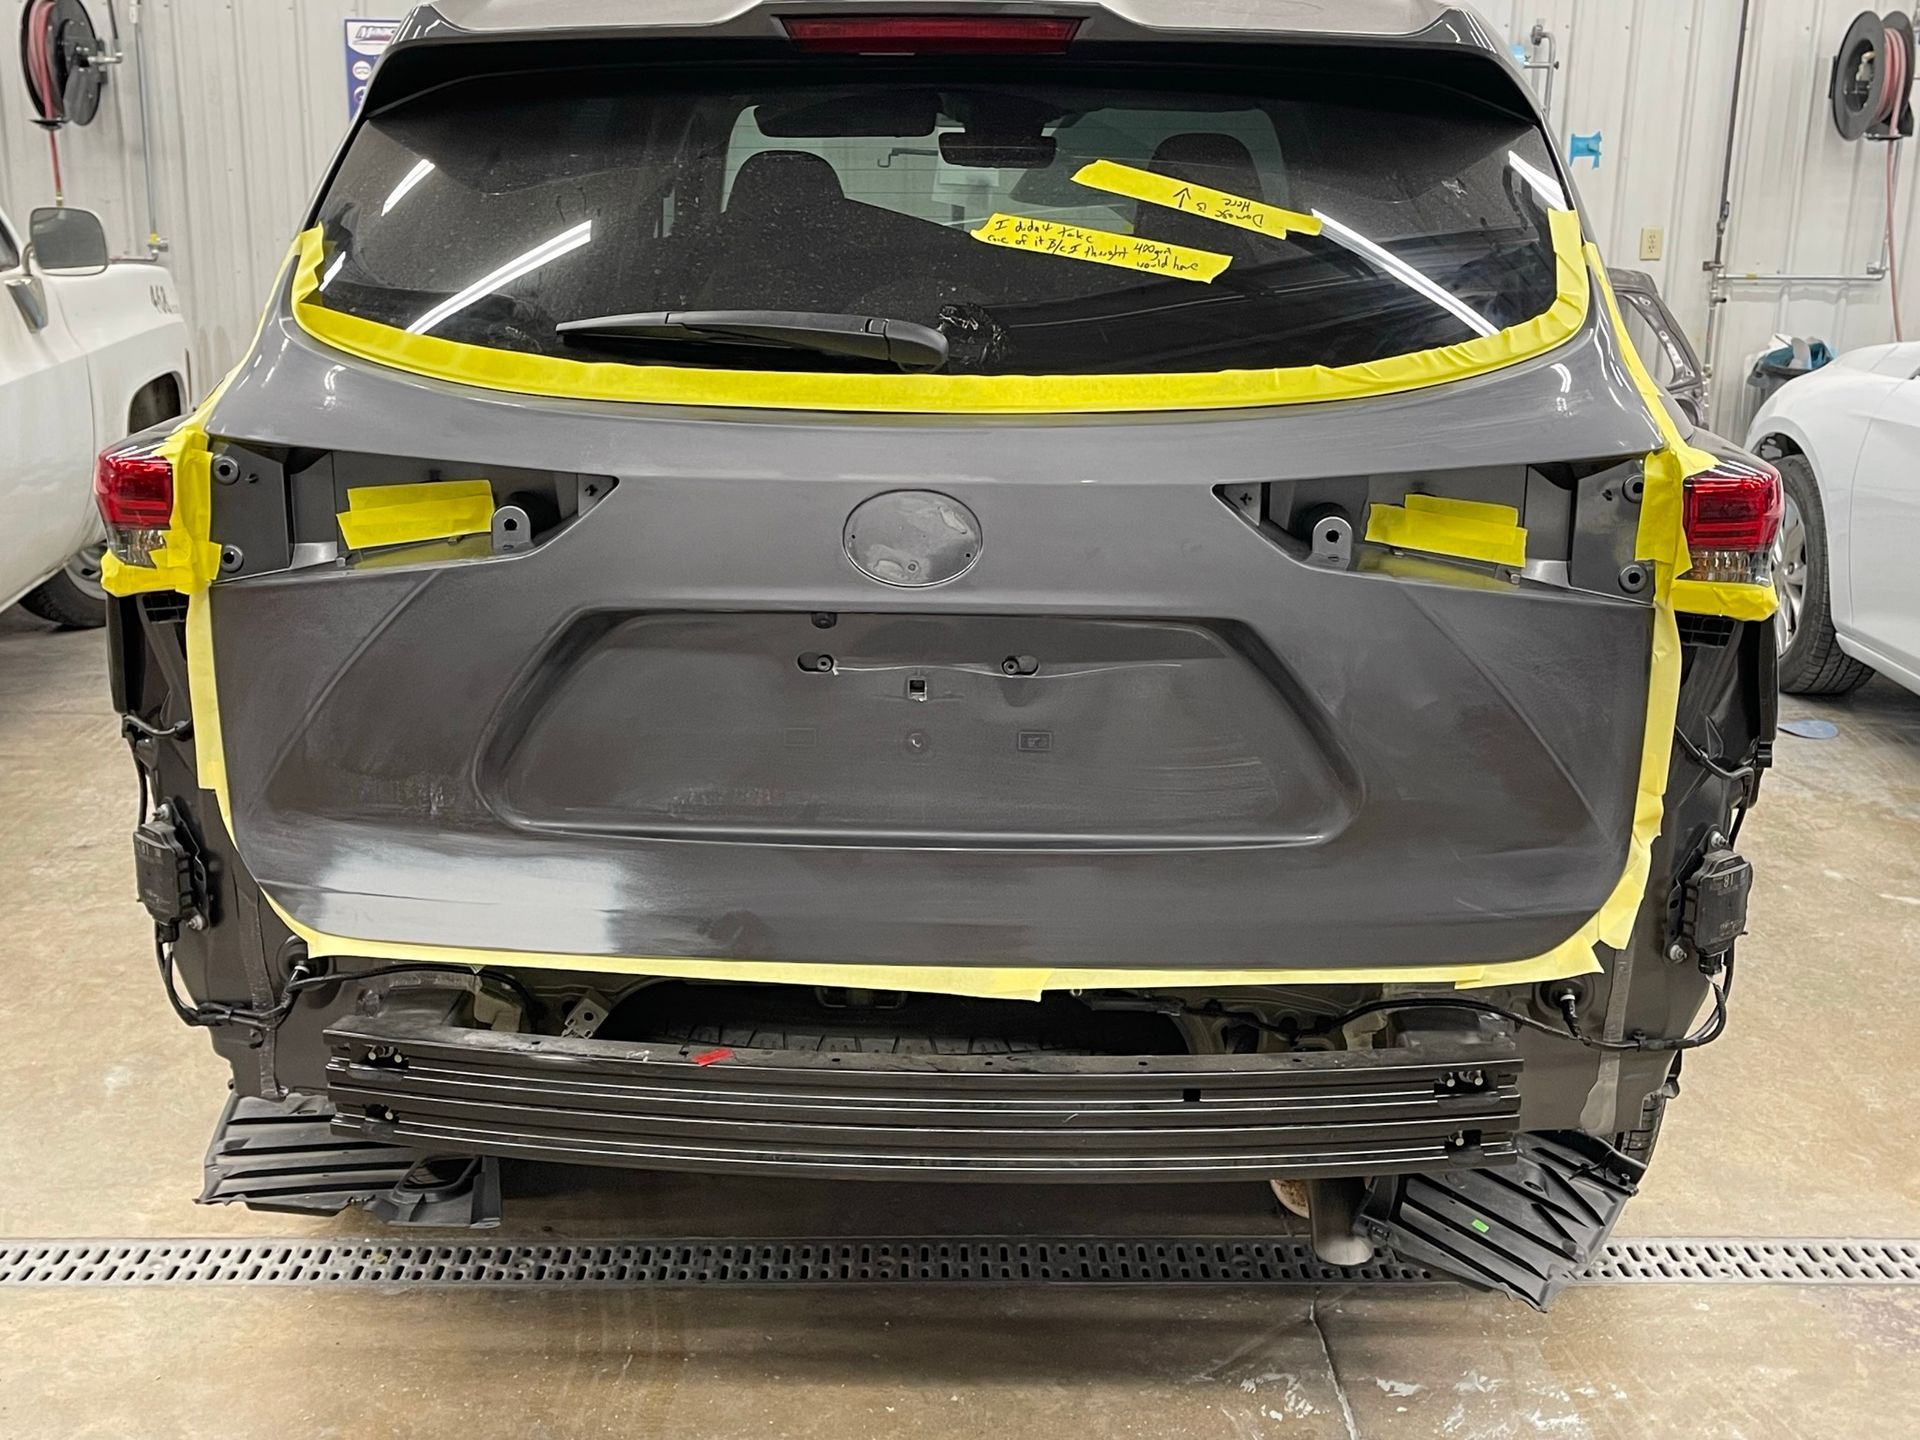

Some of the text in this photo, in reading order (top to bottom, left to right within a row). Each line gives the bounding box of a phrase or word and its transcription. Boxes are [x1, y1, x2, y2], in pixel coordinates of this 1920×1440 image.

[1221, 198, 1251, 212] Here
[994, 218, 1010, 231] I
[1057, 226, 1093, 244] take
[1015, 234, 1029, 245] of
[1034, 235, 1044, 247] it
[1067, 243, 1082, 254] I
[1136, 255, 1199, 271] would have
